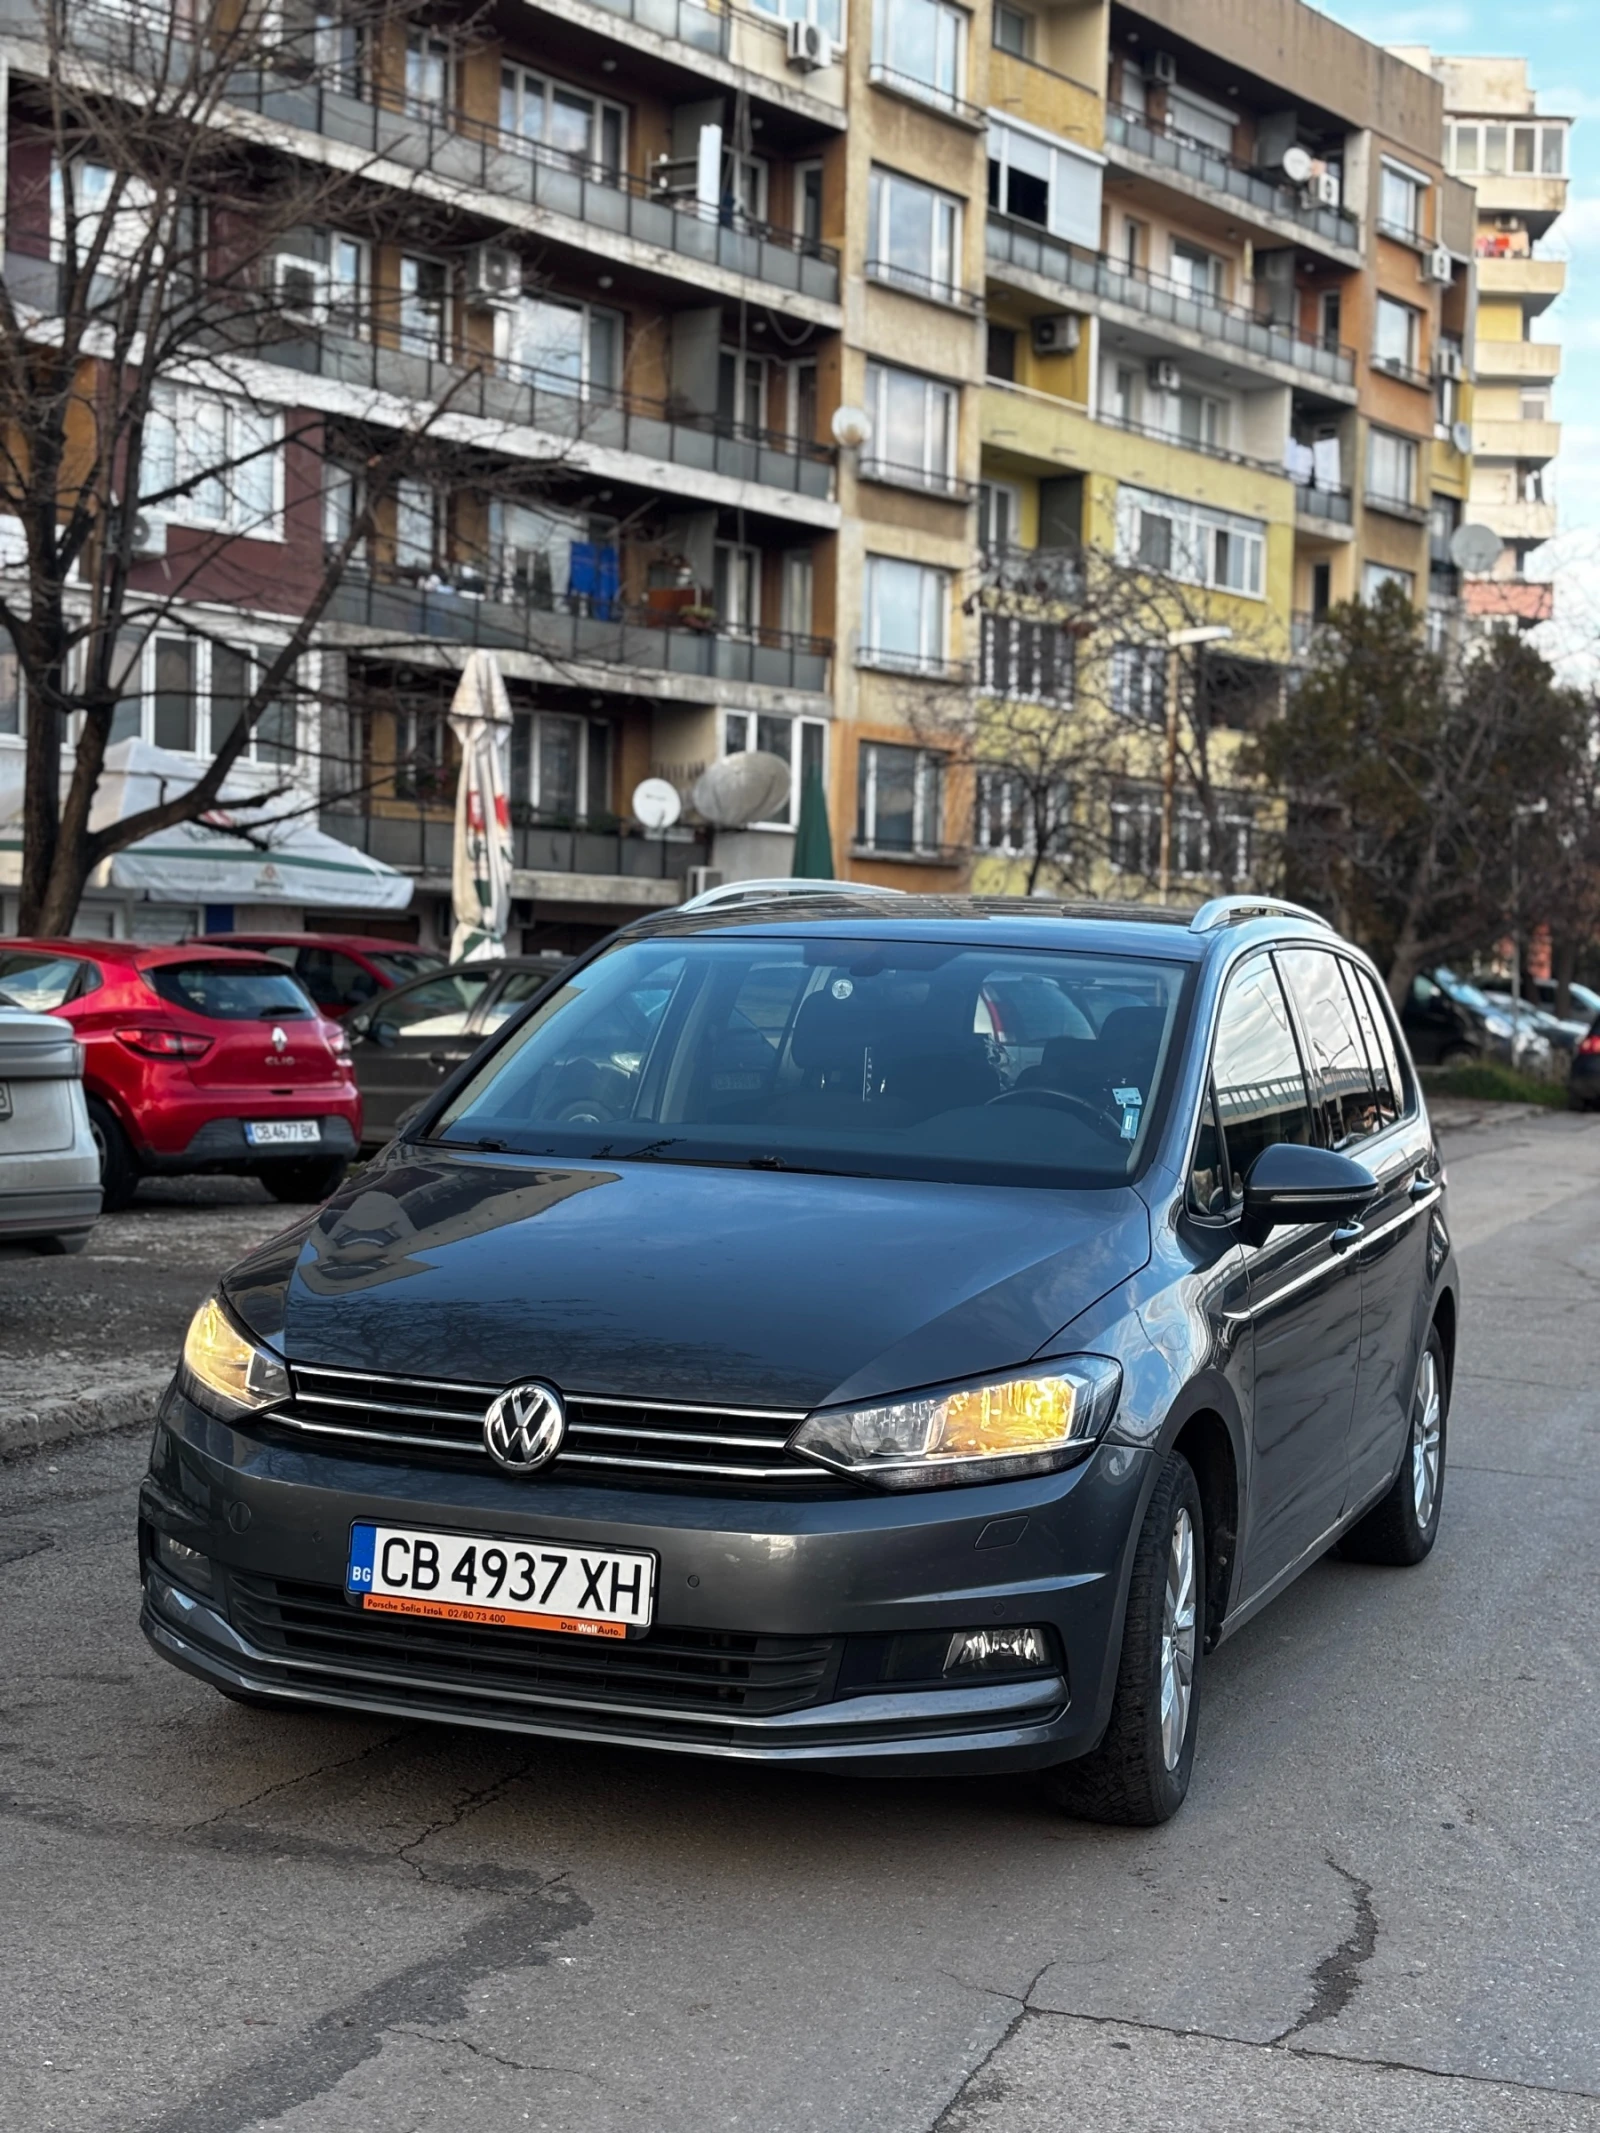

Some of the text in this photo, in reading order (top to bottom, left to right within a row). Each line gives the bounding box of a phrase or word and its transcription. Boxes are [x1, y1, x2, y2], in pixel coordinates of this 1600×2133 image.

[265, 1056, 295, 1066] CLIO
[484, 1384, 562, 1470] VW
[352, 1566, 371, 1583] BG
[381, 1537, 642, 1615] CB 4937 XH
[367, 1598, 506, 1623] Porsche Sofia Iztok 02/80 73 400
